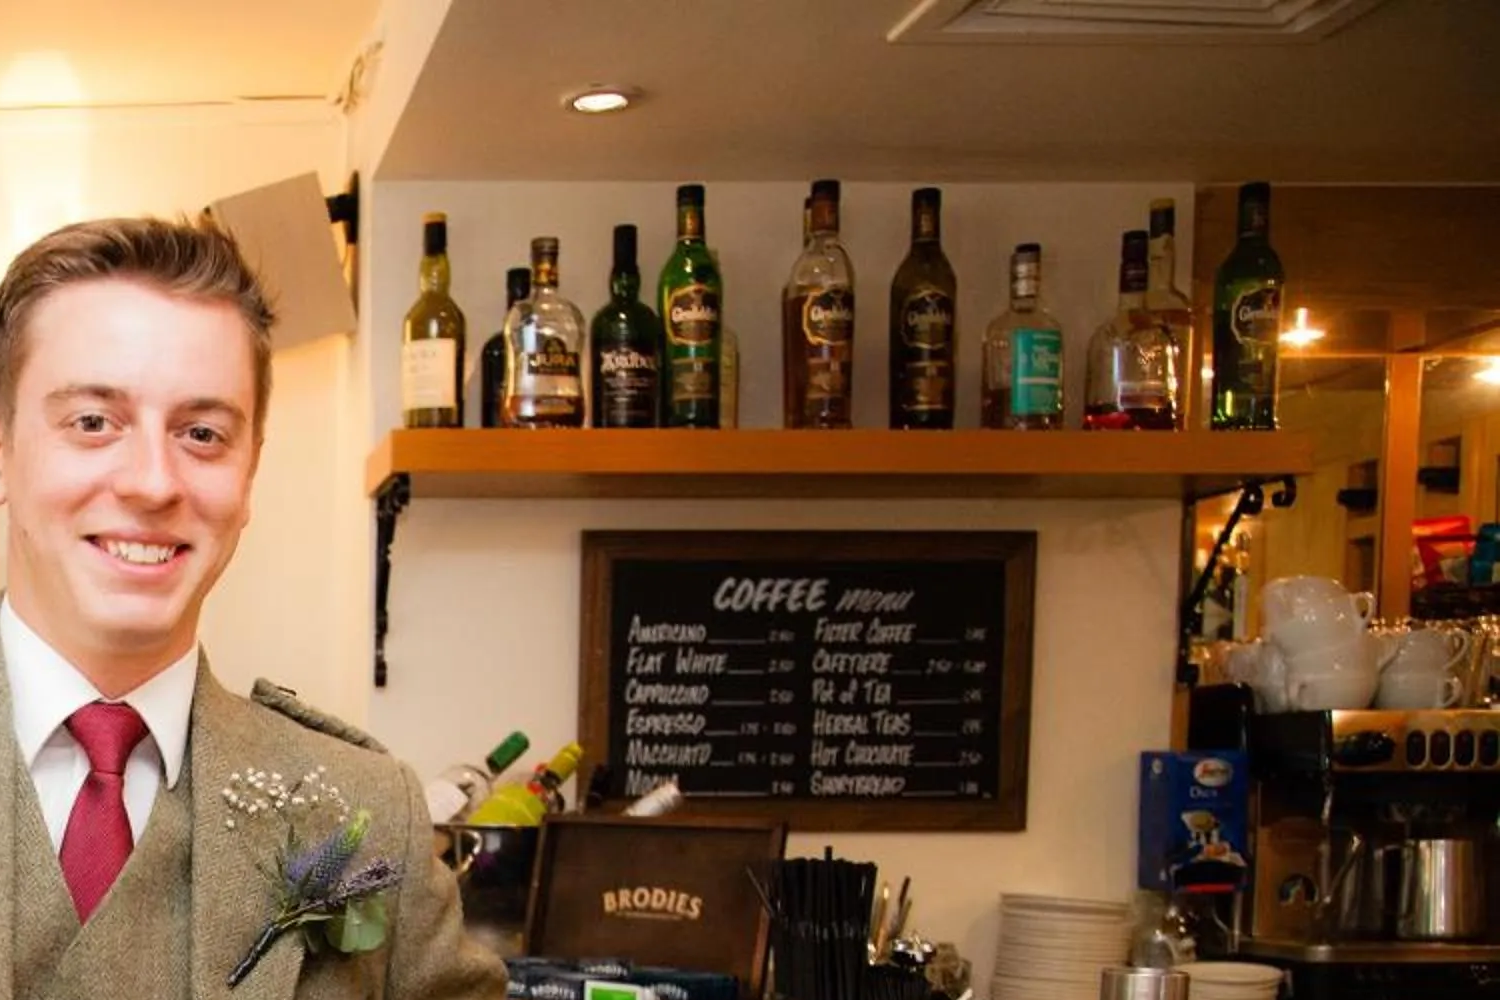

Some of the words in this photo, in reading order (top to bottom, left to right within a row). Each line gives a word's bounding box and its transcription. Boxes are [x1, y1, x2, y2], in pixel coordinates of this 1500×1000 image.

[713, 576, 830, 612] COFFEE
[627, 613, 707, 644] AMERICANO
[814, 616, 864, 644] FILTER
[865, 615, 917, 644] COFFEE
[626, 646, 667, 675] FLAT
[675, 645, 729, 675] WHITE
[625, 677, 711, 706] CAPPUCCINO
[626, 708, 707, 737] ESPRESSO
[812, 708, 869, 736] HERBAL
[871, 708, 912, 737] TEAS
[625, 739, 713, 767] MACCHIATO
[810, 738, 841, 767] HOT
[845, 738, 916, 767] CHOCOLATE
[809, 769, 907, 799] SHORTBREAD
[602, 886, 705, 920] BRODIES
